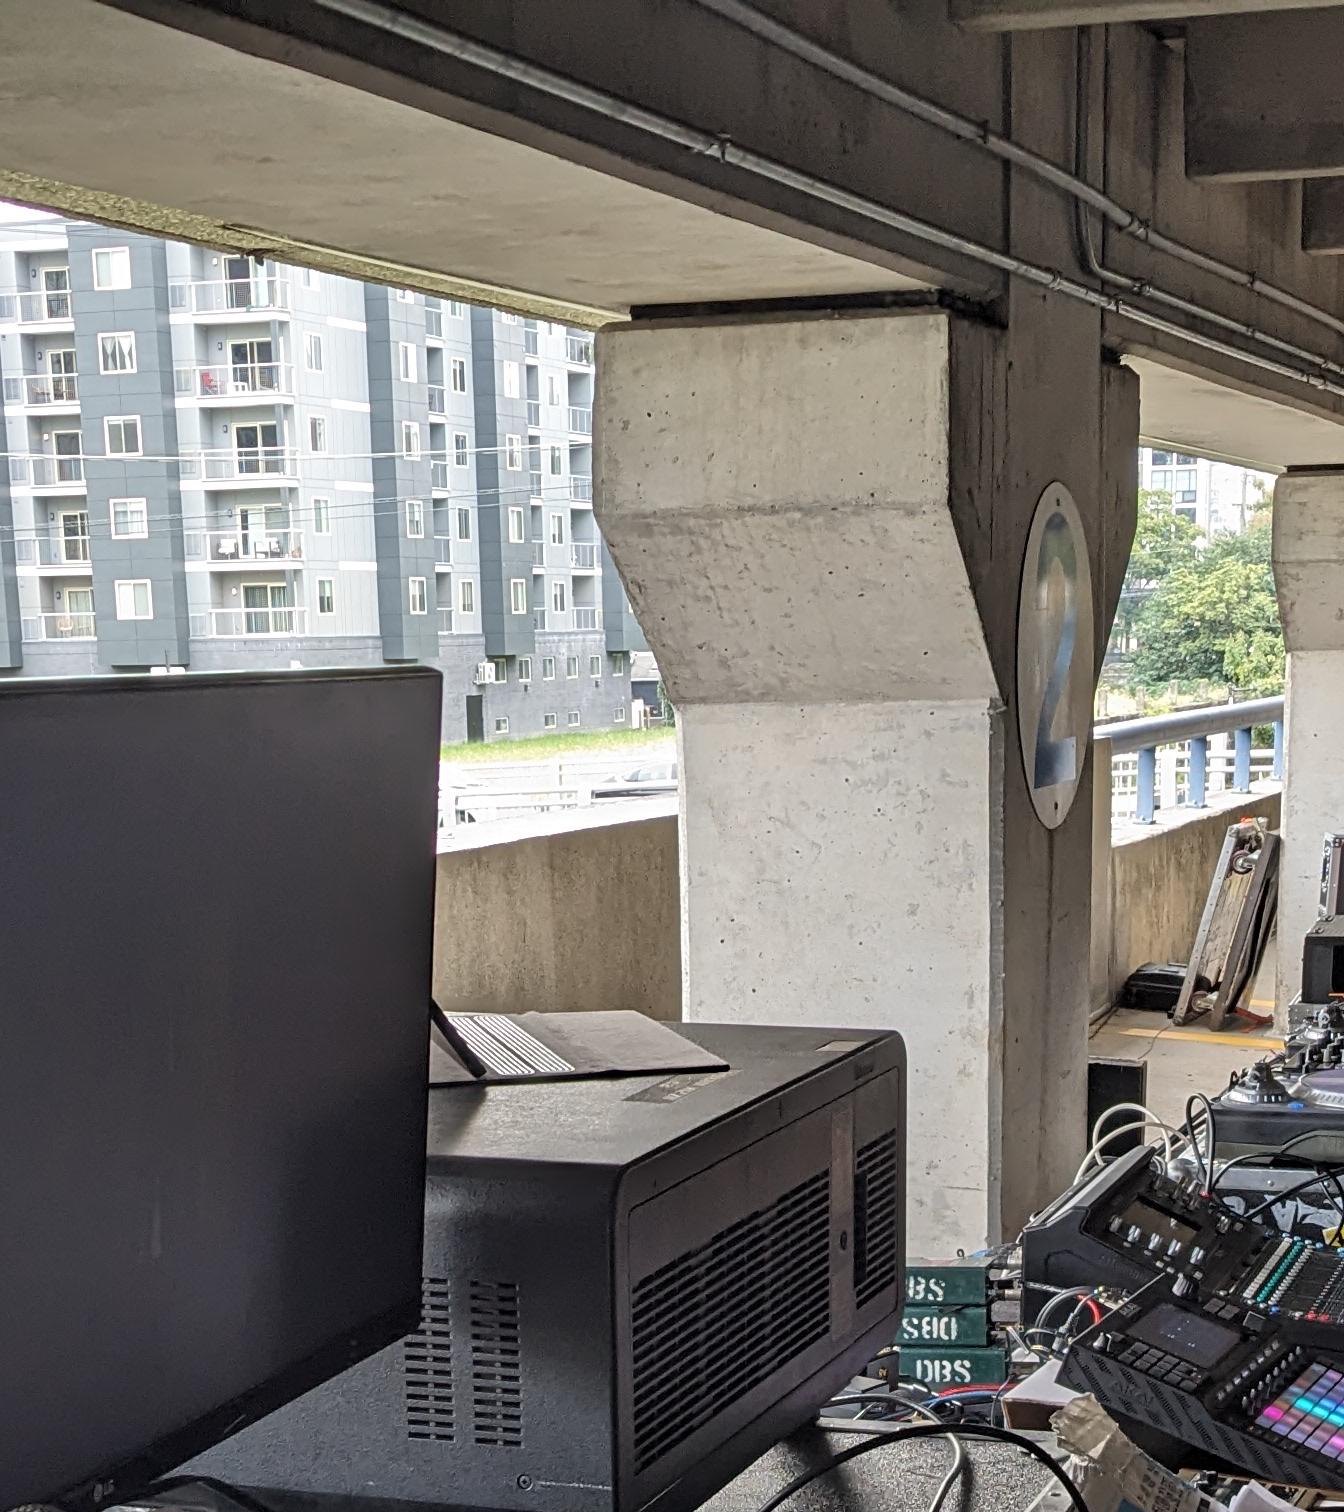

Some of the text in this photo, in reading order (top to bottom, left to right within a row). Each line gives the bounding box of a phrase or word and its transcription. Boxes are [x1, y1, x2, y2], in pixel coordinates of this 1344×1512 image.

[1033, 510, 1077, 790] 2
[905, 1275, 946, 1302] BS
[916, 1359, 972, 1383] DBS
